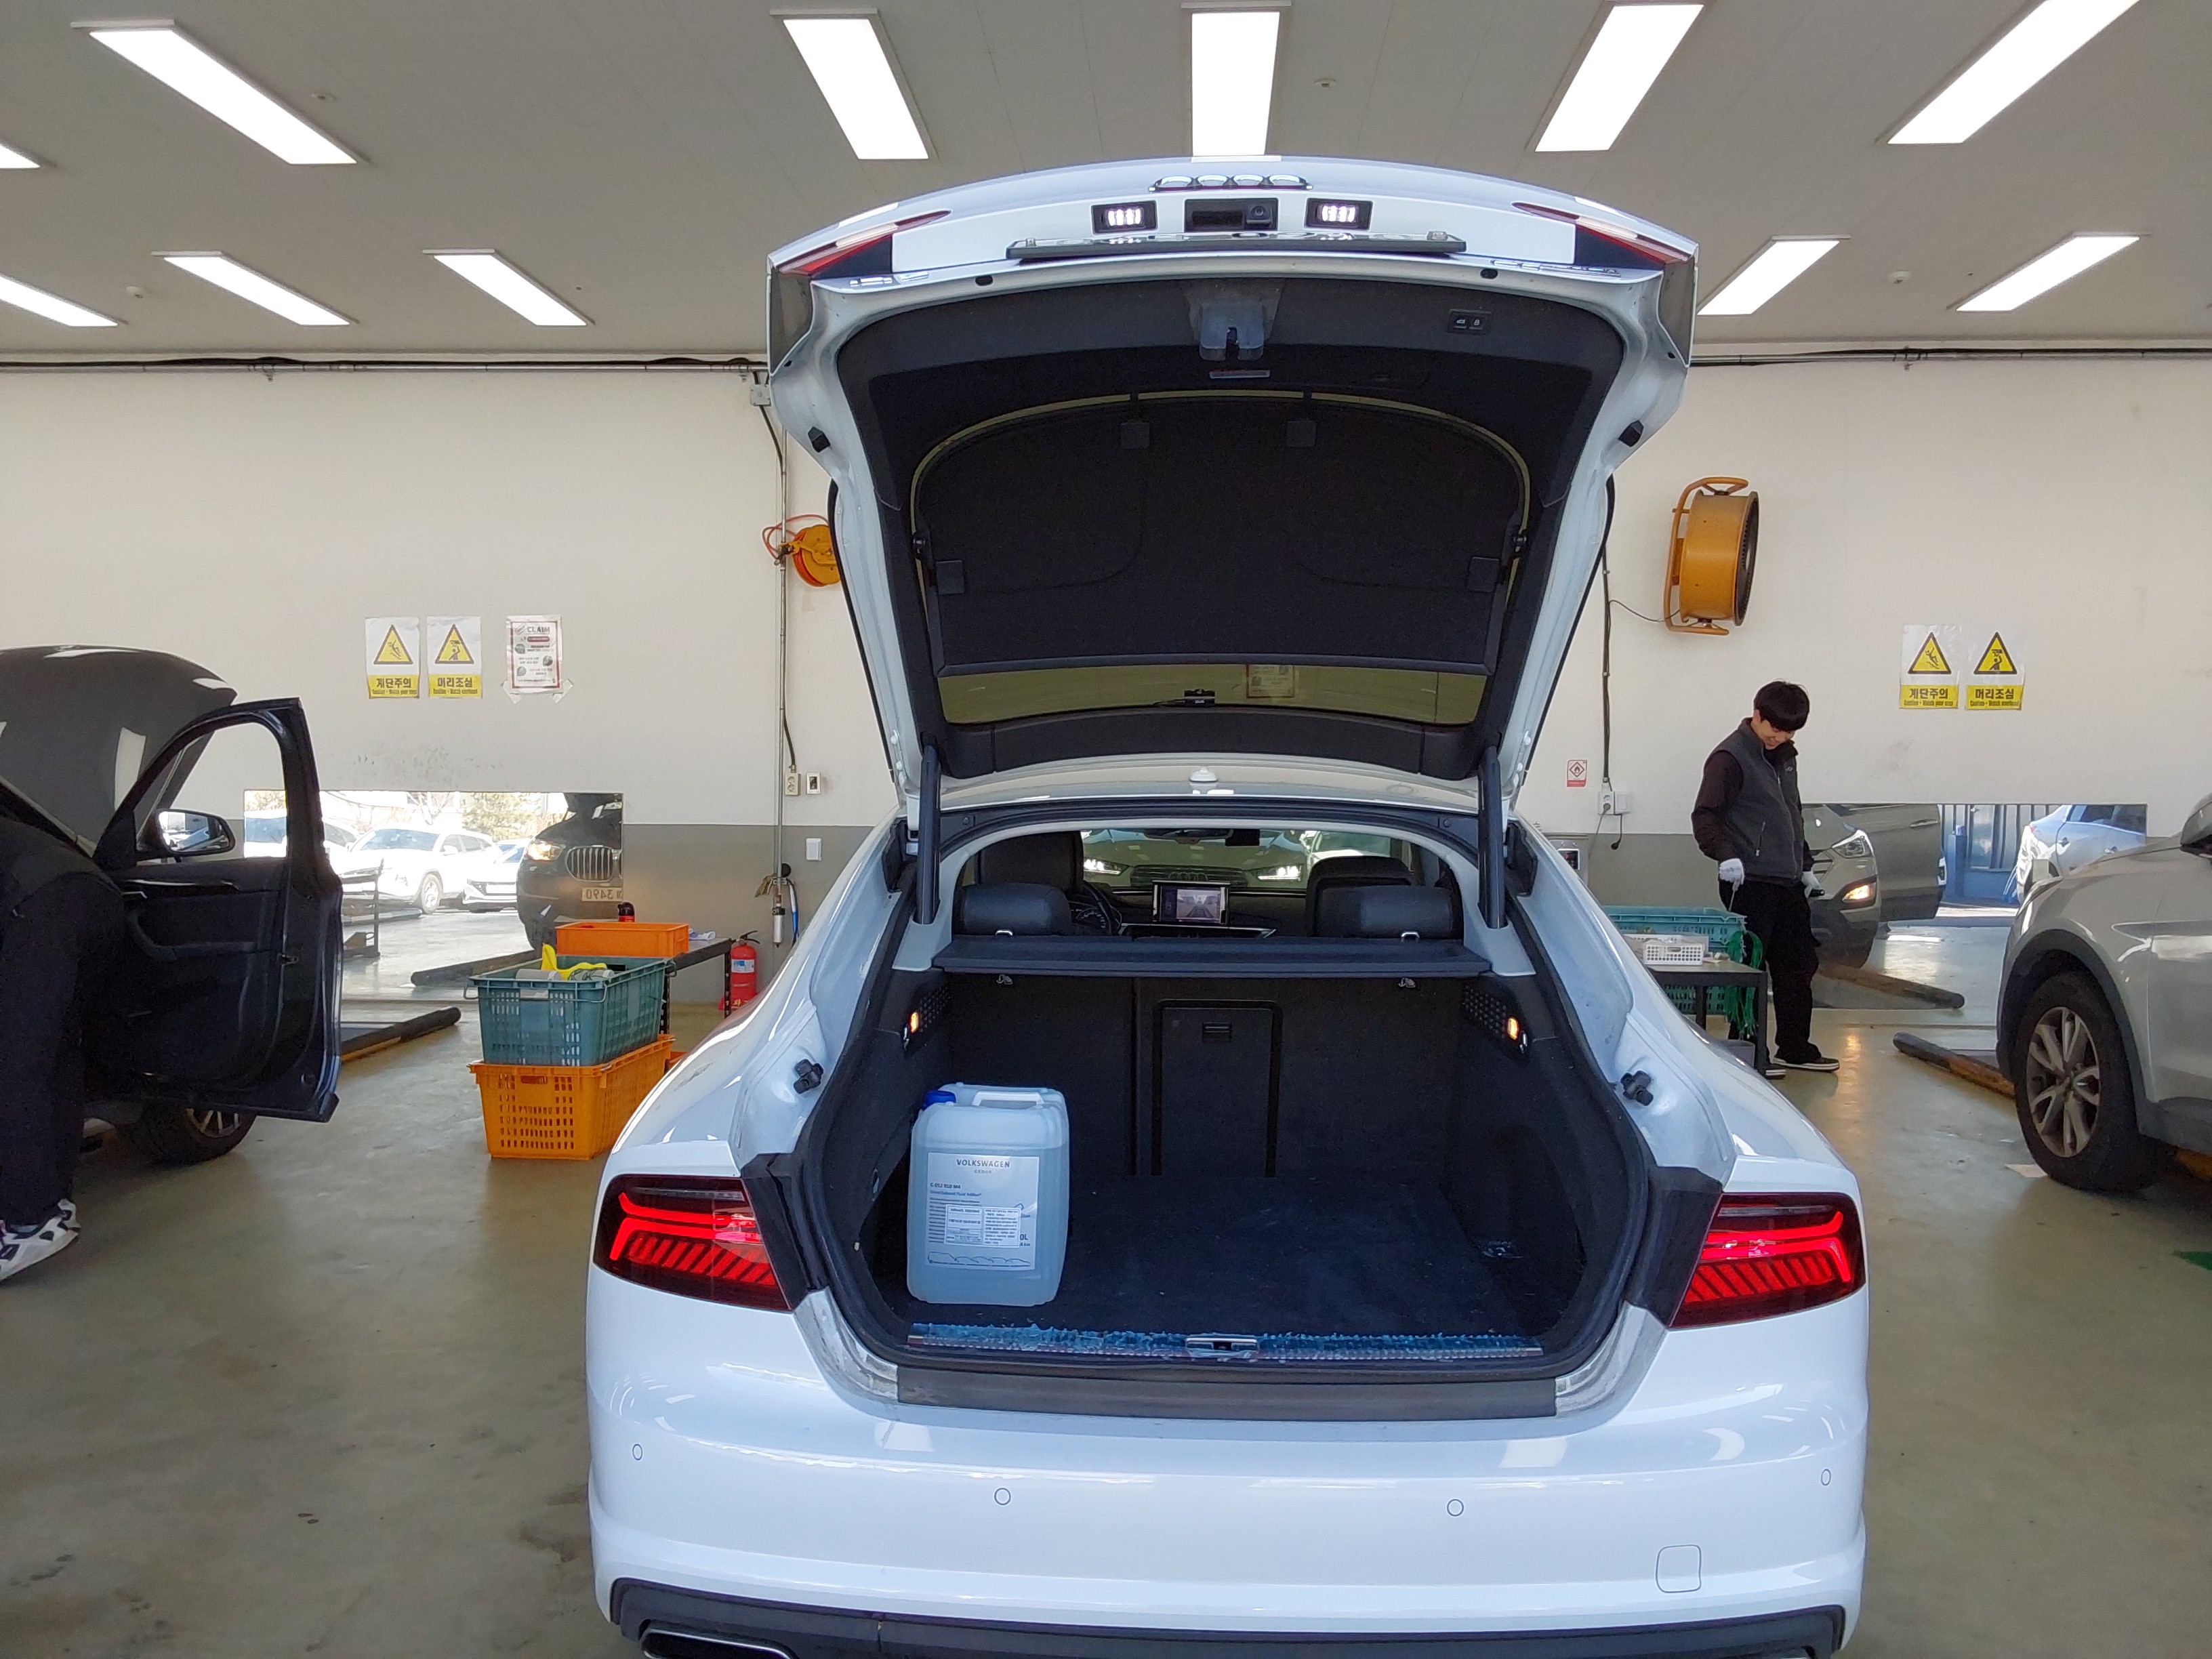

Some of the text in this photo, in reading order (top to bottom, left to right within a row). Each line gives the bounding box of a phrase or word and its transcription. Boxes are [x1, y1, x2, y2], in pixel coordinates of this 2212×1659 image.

[376, 678, 411, 689] 계단주의
[437, 677, 472, 688] 머리조심
[1909, 688, 1948, 699] 계단주의
[1975, 688, 2014, 699] 머리조심
[956, 1159, 1010, 1168] VOLKSWAGEN
